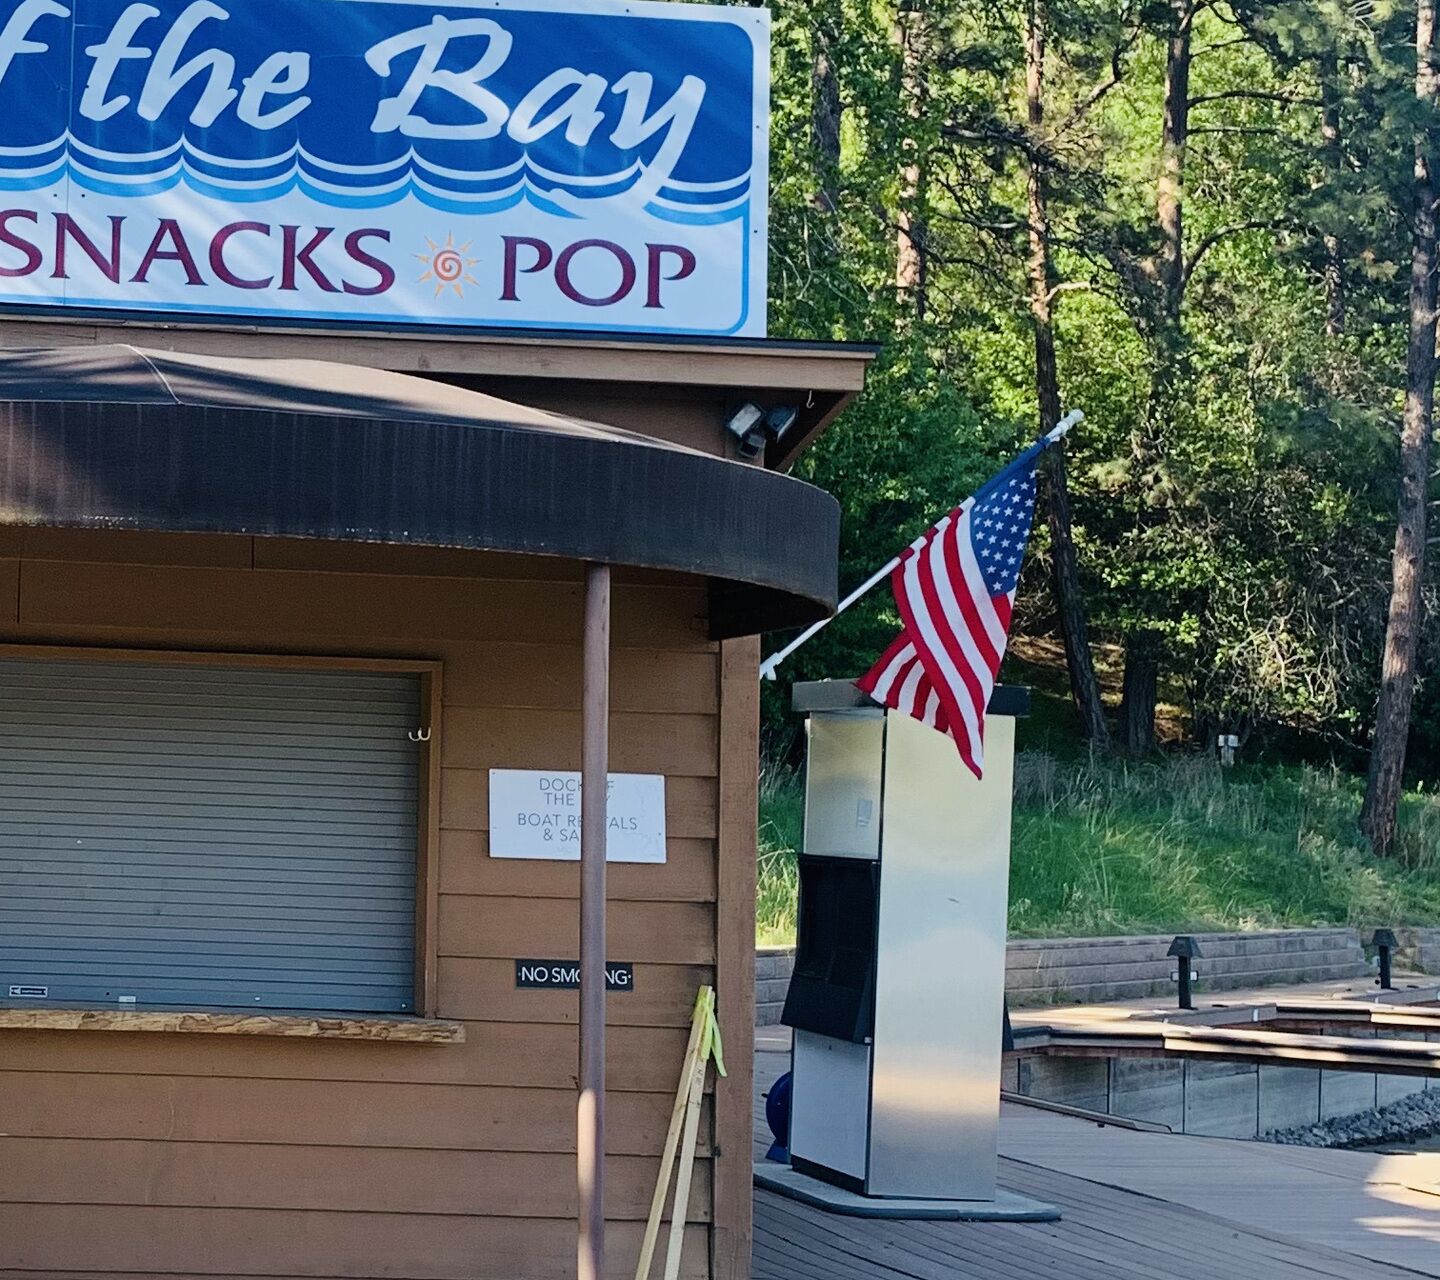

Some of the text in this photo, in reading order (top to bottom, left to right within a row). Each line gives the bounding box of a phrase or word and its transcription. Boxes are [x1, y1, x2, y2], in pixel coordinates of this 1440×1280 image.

[79, 0, 312, 131] the
[364, 13, 707, 218] Bay
[499, 234, 697, 310] POP
[545, 793, 575, 806] THE
[518, 813, 638, 830] BOAT REALS
[521, 967, 628, 985] NO SMNG
